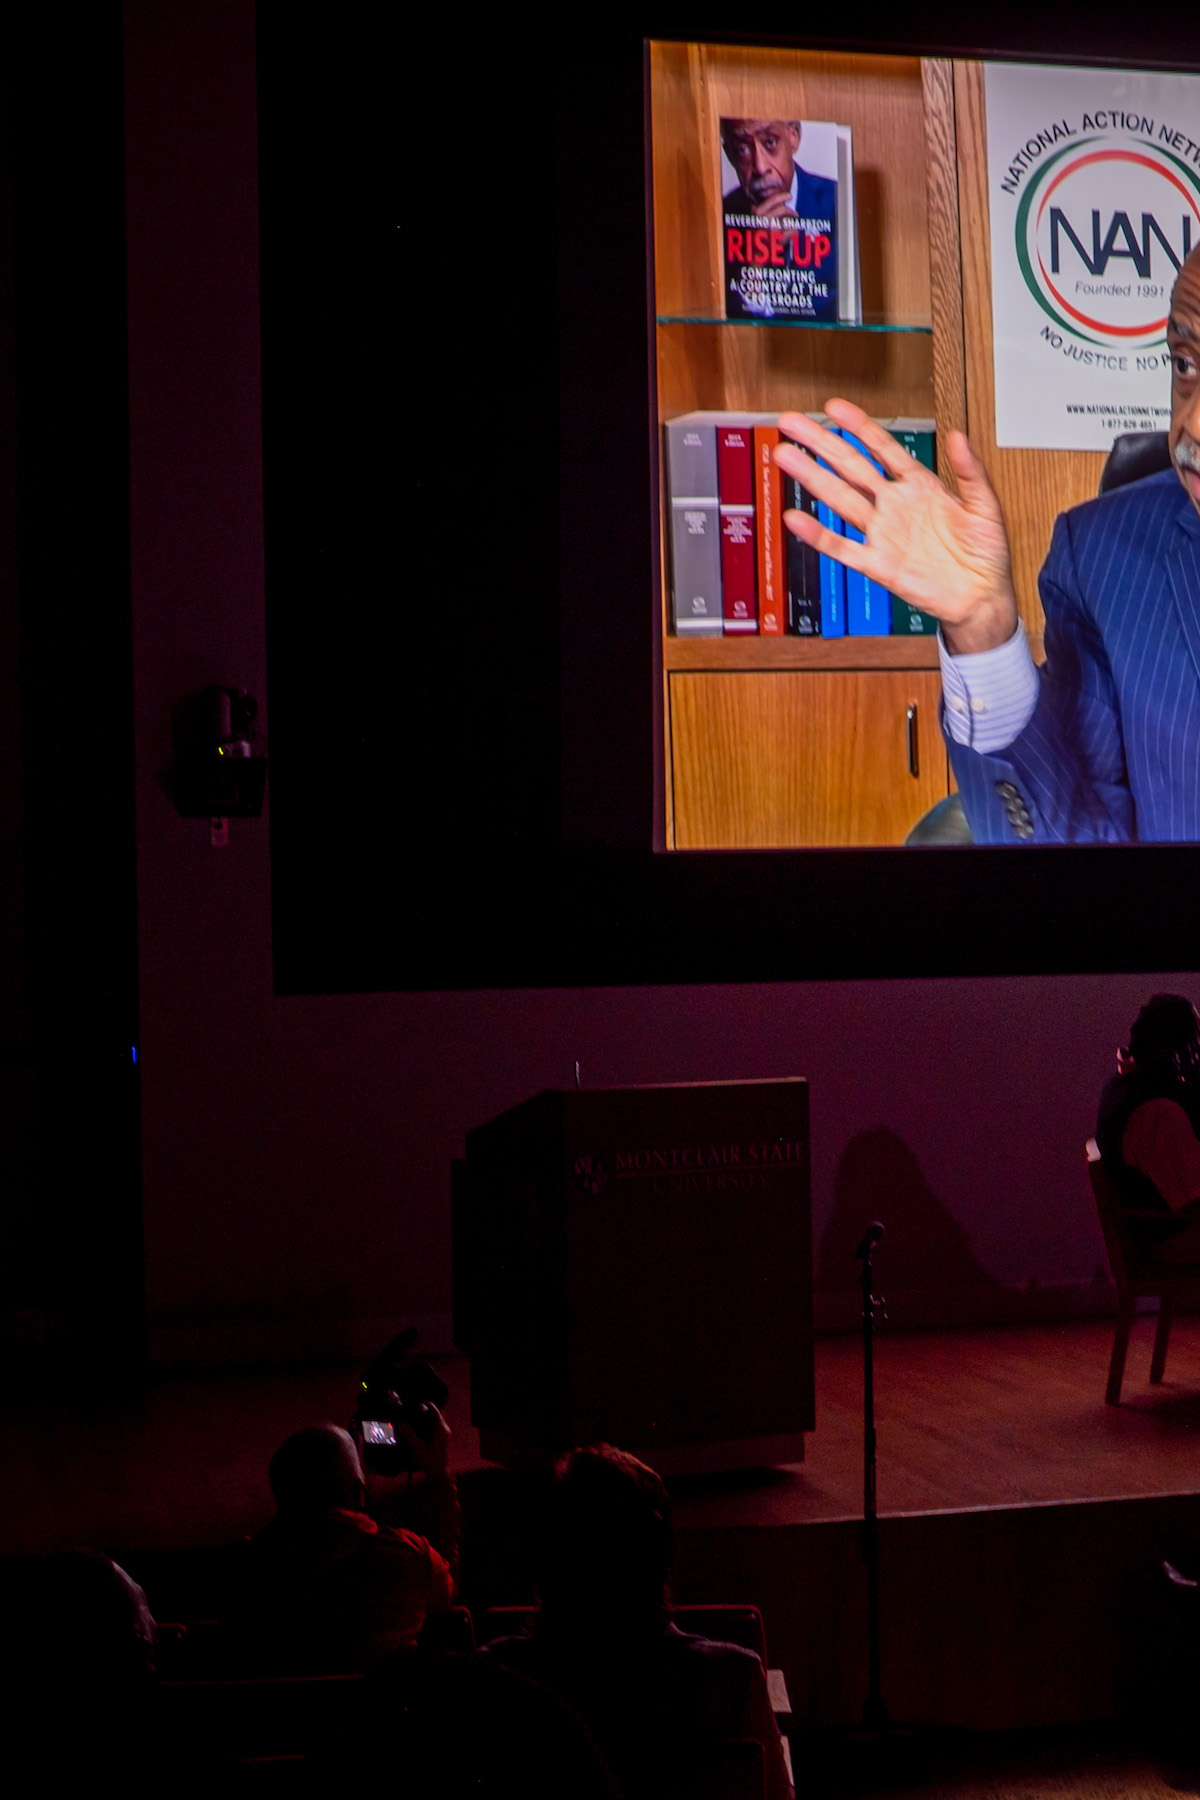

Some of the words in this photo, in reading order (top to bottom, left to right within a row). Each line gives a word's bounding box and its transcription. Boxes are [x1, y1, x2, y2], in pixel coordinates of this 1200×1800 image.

[1000, 119, 1077, 196] NATIONAL
[1082, 110, 1154, 137] ACTION
[725, 213, 770, 229] REVEREND
[770, 217, 781, 229] AL
[783, 217, 831, 233] SHARPTON
[727, 228, 785, 266] RISE
[792, 233, 831, 269] UP
[1049, 206, 1191, 279] NAN
[741, 266, 816, 284] CONFRONTING
[730, 278, 737, 292] A
[740, 279, 788, 295] COUNTRY
[792, 282, 804, 295] AT
[808, 282, 828, 298] THE
[1075, 280, 1131, 296] Founded
[1136, 284, 1164, 298] 1991
[745, 291, 813, 309] CROSSROADS
[1040, 326, 1063, 350] NO
[1063, 344, 1128, 372] JUSTICE
[1136, 356, 1159, 372] NO
